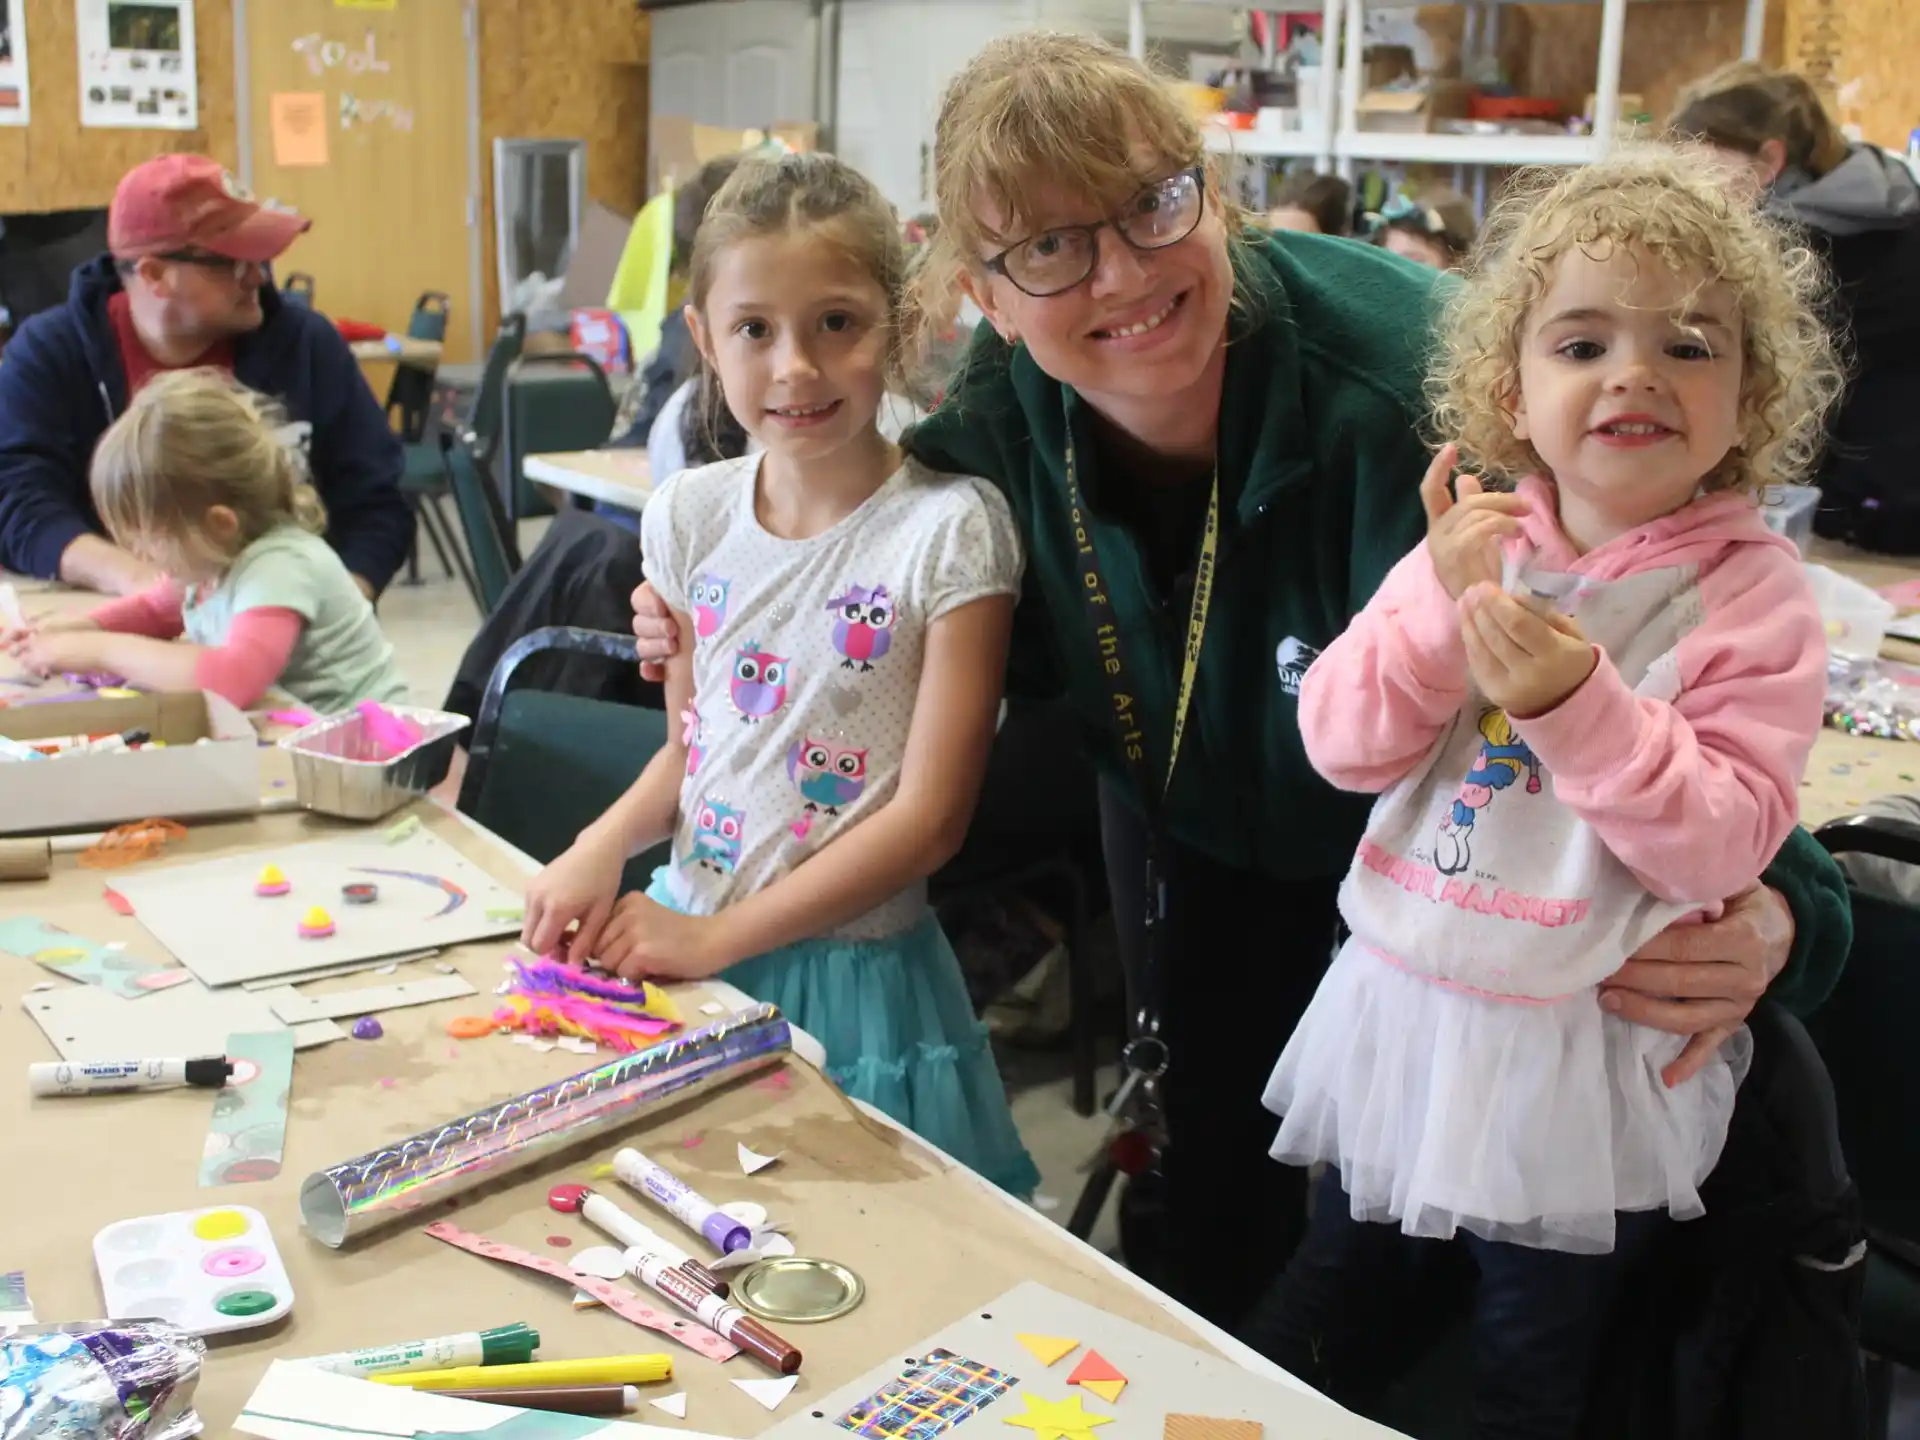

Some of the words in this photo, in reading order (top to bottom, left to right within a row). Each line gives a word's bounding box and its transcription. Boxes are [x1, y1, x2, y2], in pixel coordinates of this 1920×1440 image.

[1084, 572, 1106, 605] of
[1096, 625, 1121, 674] the
[1113, 692, 1143, 762] Arts
